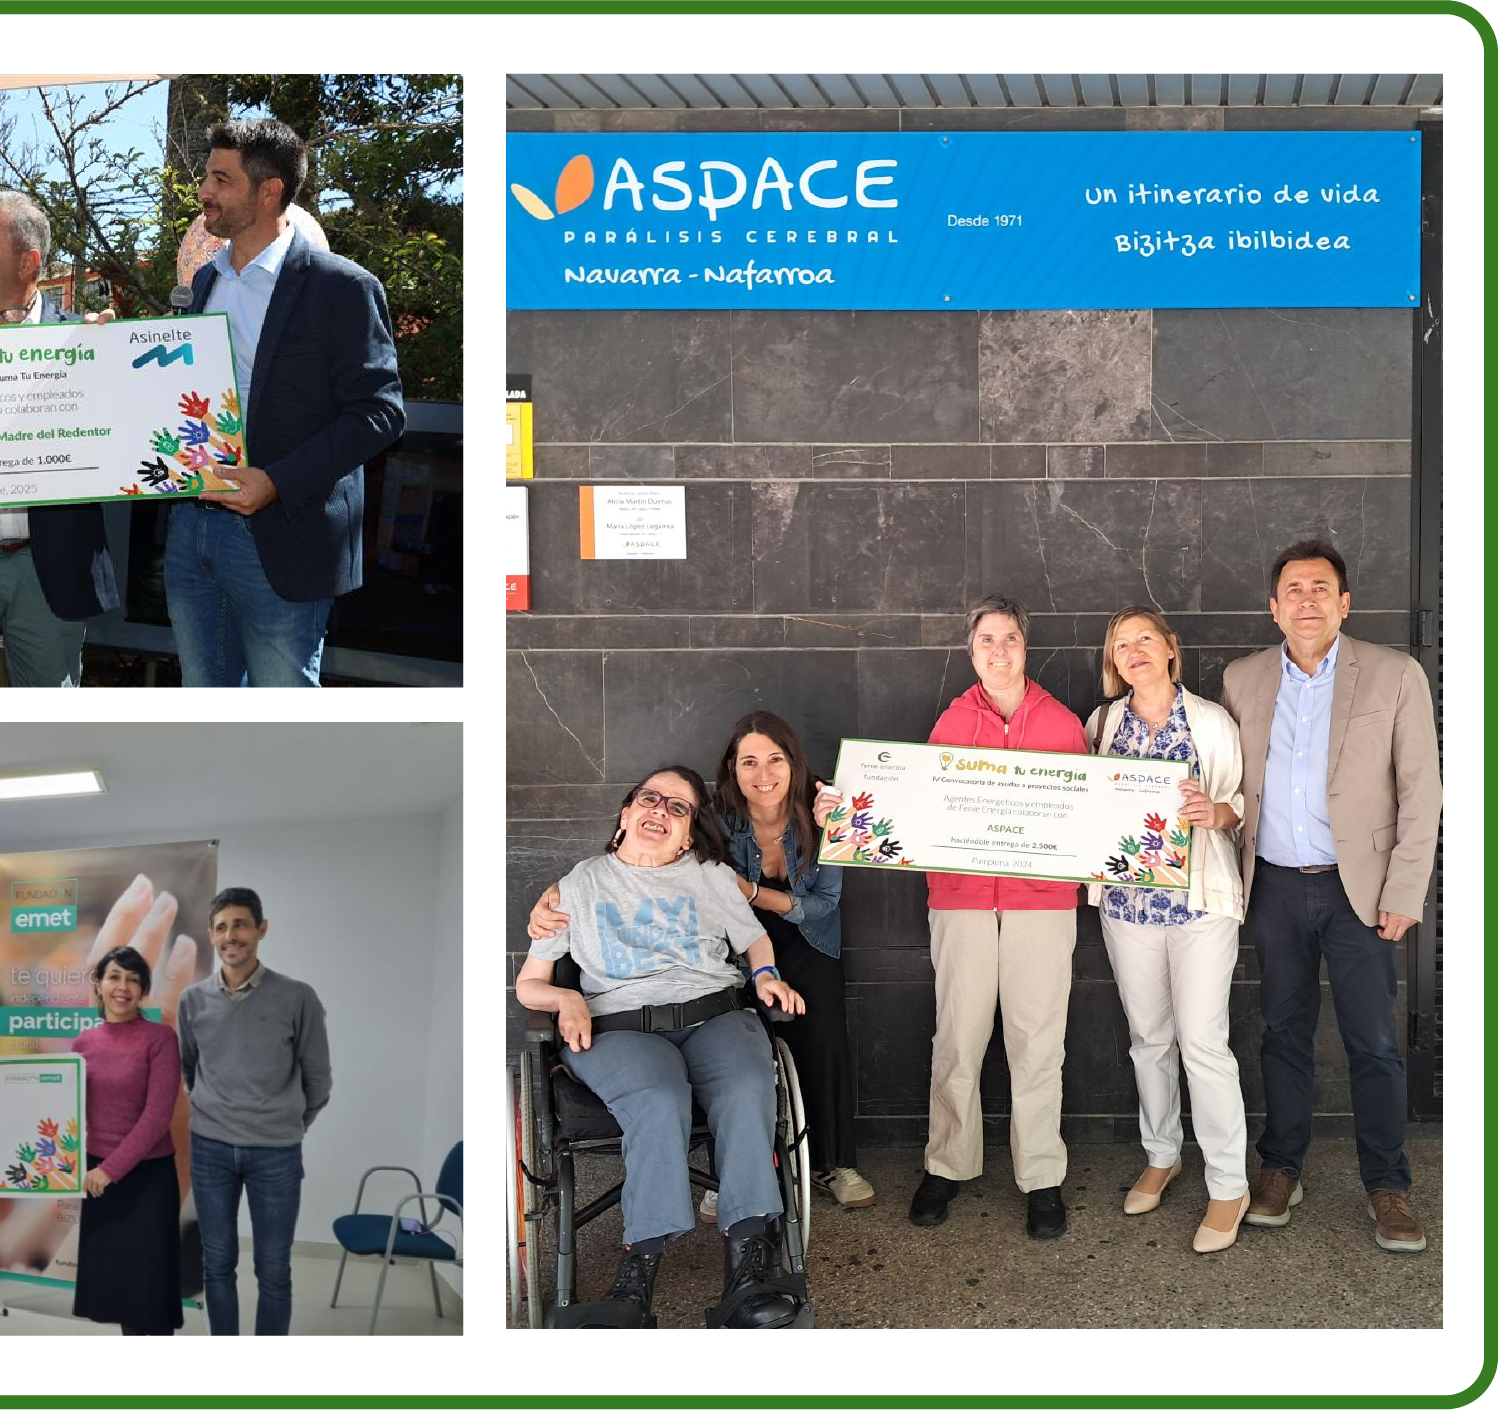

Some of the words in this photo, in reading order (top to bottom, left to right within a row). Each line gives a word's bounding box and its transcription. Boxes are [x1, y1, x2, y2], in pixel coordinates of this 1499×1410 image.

[603, 156, 899, 222] ASPACE
[1129, 184, 1262, 205] itinerario
[1273, 184, 1309, 205] de
[1321, 184, 1381, 205] vida
[947, 214, 989, 228] Desde
[993, 214, 1023, 228] 1971
[564, 228, 723, 244] PARÁLISIS
[746, 230, 899, 244] CEREBRAL
[1115, 229, 1215, 257] Bizitza
[1228, 229, 1351, 251] ibilbidea
[564, 264, 681, 285] Navarra
[704, 259, 835, 291] Nafarroa
[129, 329, 192, 344] Asinelte
[19, 343, 95, 366] energía
[20, 372, 32, 381] Tu
[26, 389, 84, 403] empleados
[4, 403, 58, 415] colaboran
[59, 402, 78, 412] con
[36, 428, 54, 439] del
[58, 426, 112, 438] Redentor
[22, 456, 34, 466] de
[38, 454, 72, 465] 1.000€
[10, 483, 38, 495] 2025
[955, 758, 1008, 775] suma
[1014, 765, 1026, 776] tu
[941, 776, 985, 786] Convocatoria
[987, 779, 996, 787] de
[997, 780, 1020, 789] ayudas
[1027, 783, 1061, 792] proyectos
[1062, 785, 1089, 793] sociales
[1122, 773, 1171, 785] ASPACE
[943, 794, 976, 804] Agentes
[977, 796, 1024, 807] Energéticos
[1030, 800, 1074, 811] empleados
[958, 804, 981, 813] Fenie
[1012, 808, 1052, 819] colaboran
[1054, 812, 1068, 820] con
[987, 824, 1025, 835] ASPACE
[950, 836, 990, 847] haciéndole
[992, 839, 1019, 849] entrega
[1021, 841, 1030, 849] de
[1031, 842, 1058, 851] 2.500€
[1012, 859, 1032, 869] 2024
[15, 908, 71, 928] emet
[11, 966, 31, 985] te
[9, 993, 86, 1004] independiente
[57, 1199, 78, 1211] Para
